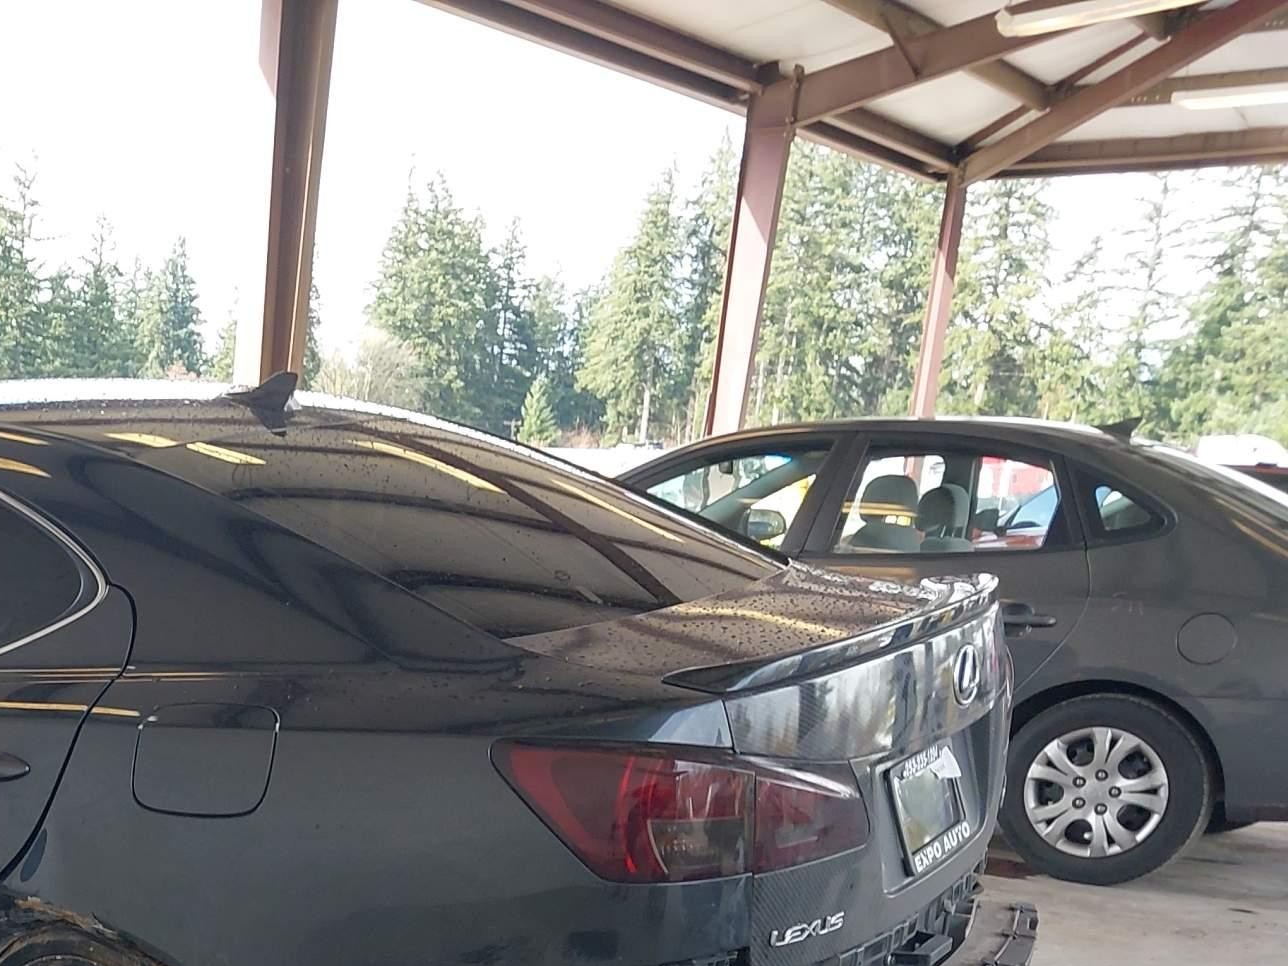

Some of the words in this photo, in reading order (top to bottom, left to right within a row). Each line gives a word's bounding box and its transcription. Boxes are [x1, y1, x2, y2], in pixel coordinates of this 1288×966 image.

[914, 841, 943, 873] EXPO
[943, 821, 971, 853] AUTO
[770, 910, 845, 947] LEXUS
